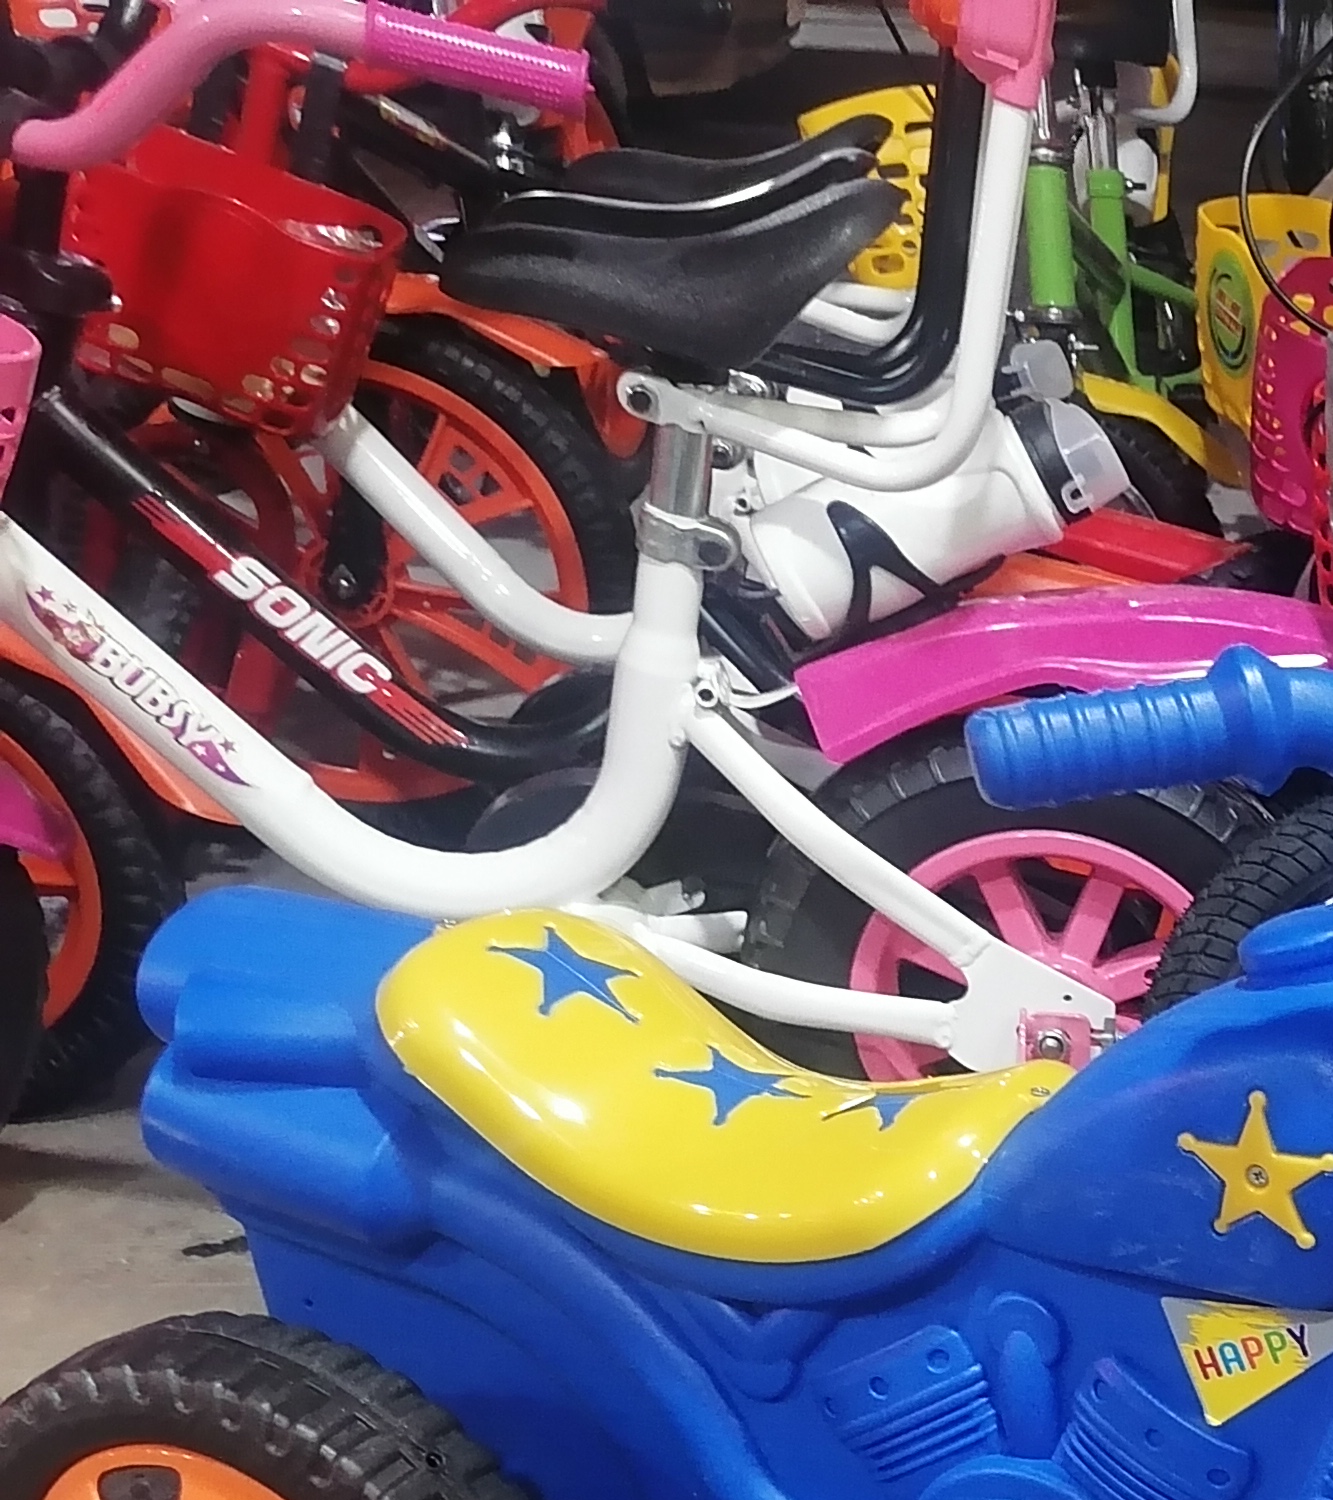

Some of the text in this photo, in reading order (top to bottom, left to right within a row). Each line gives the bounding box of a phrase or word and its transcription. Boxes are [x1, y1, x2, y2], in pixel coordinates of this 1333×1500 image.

[212, 555, 393, 694] SONIC
[91, 636, 223, 748] BUBSY
[1194, 1323, 1309, 1380] HAPPY
